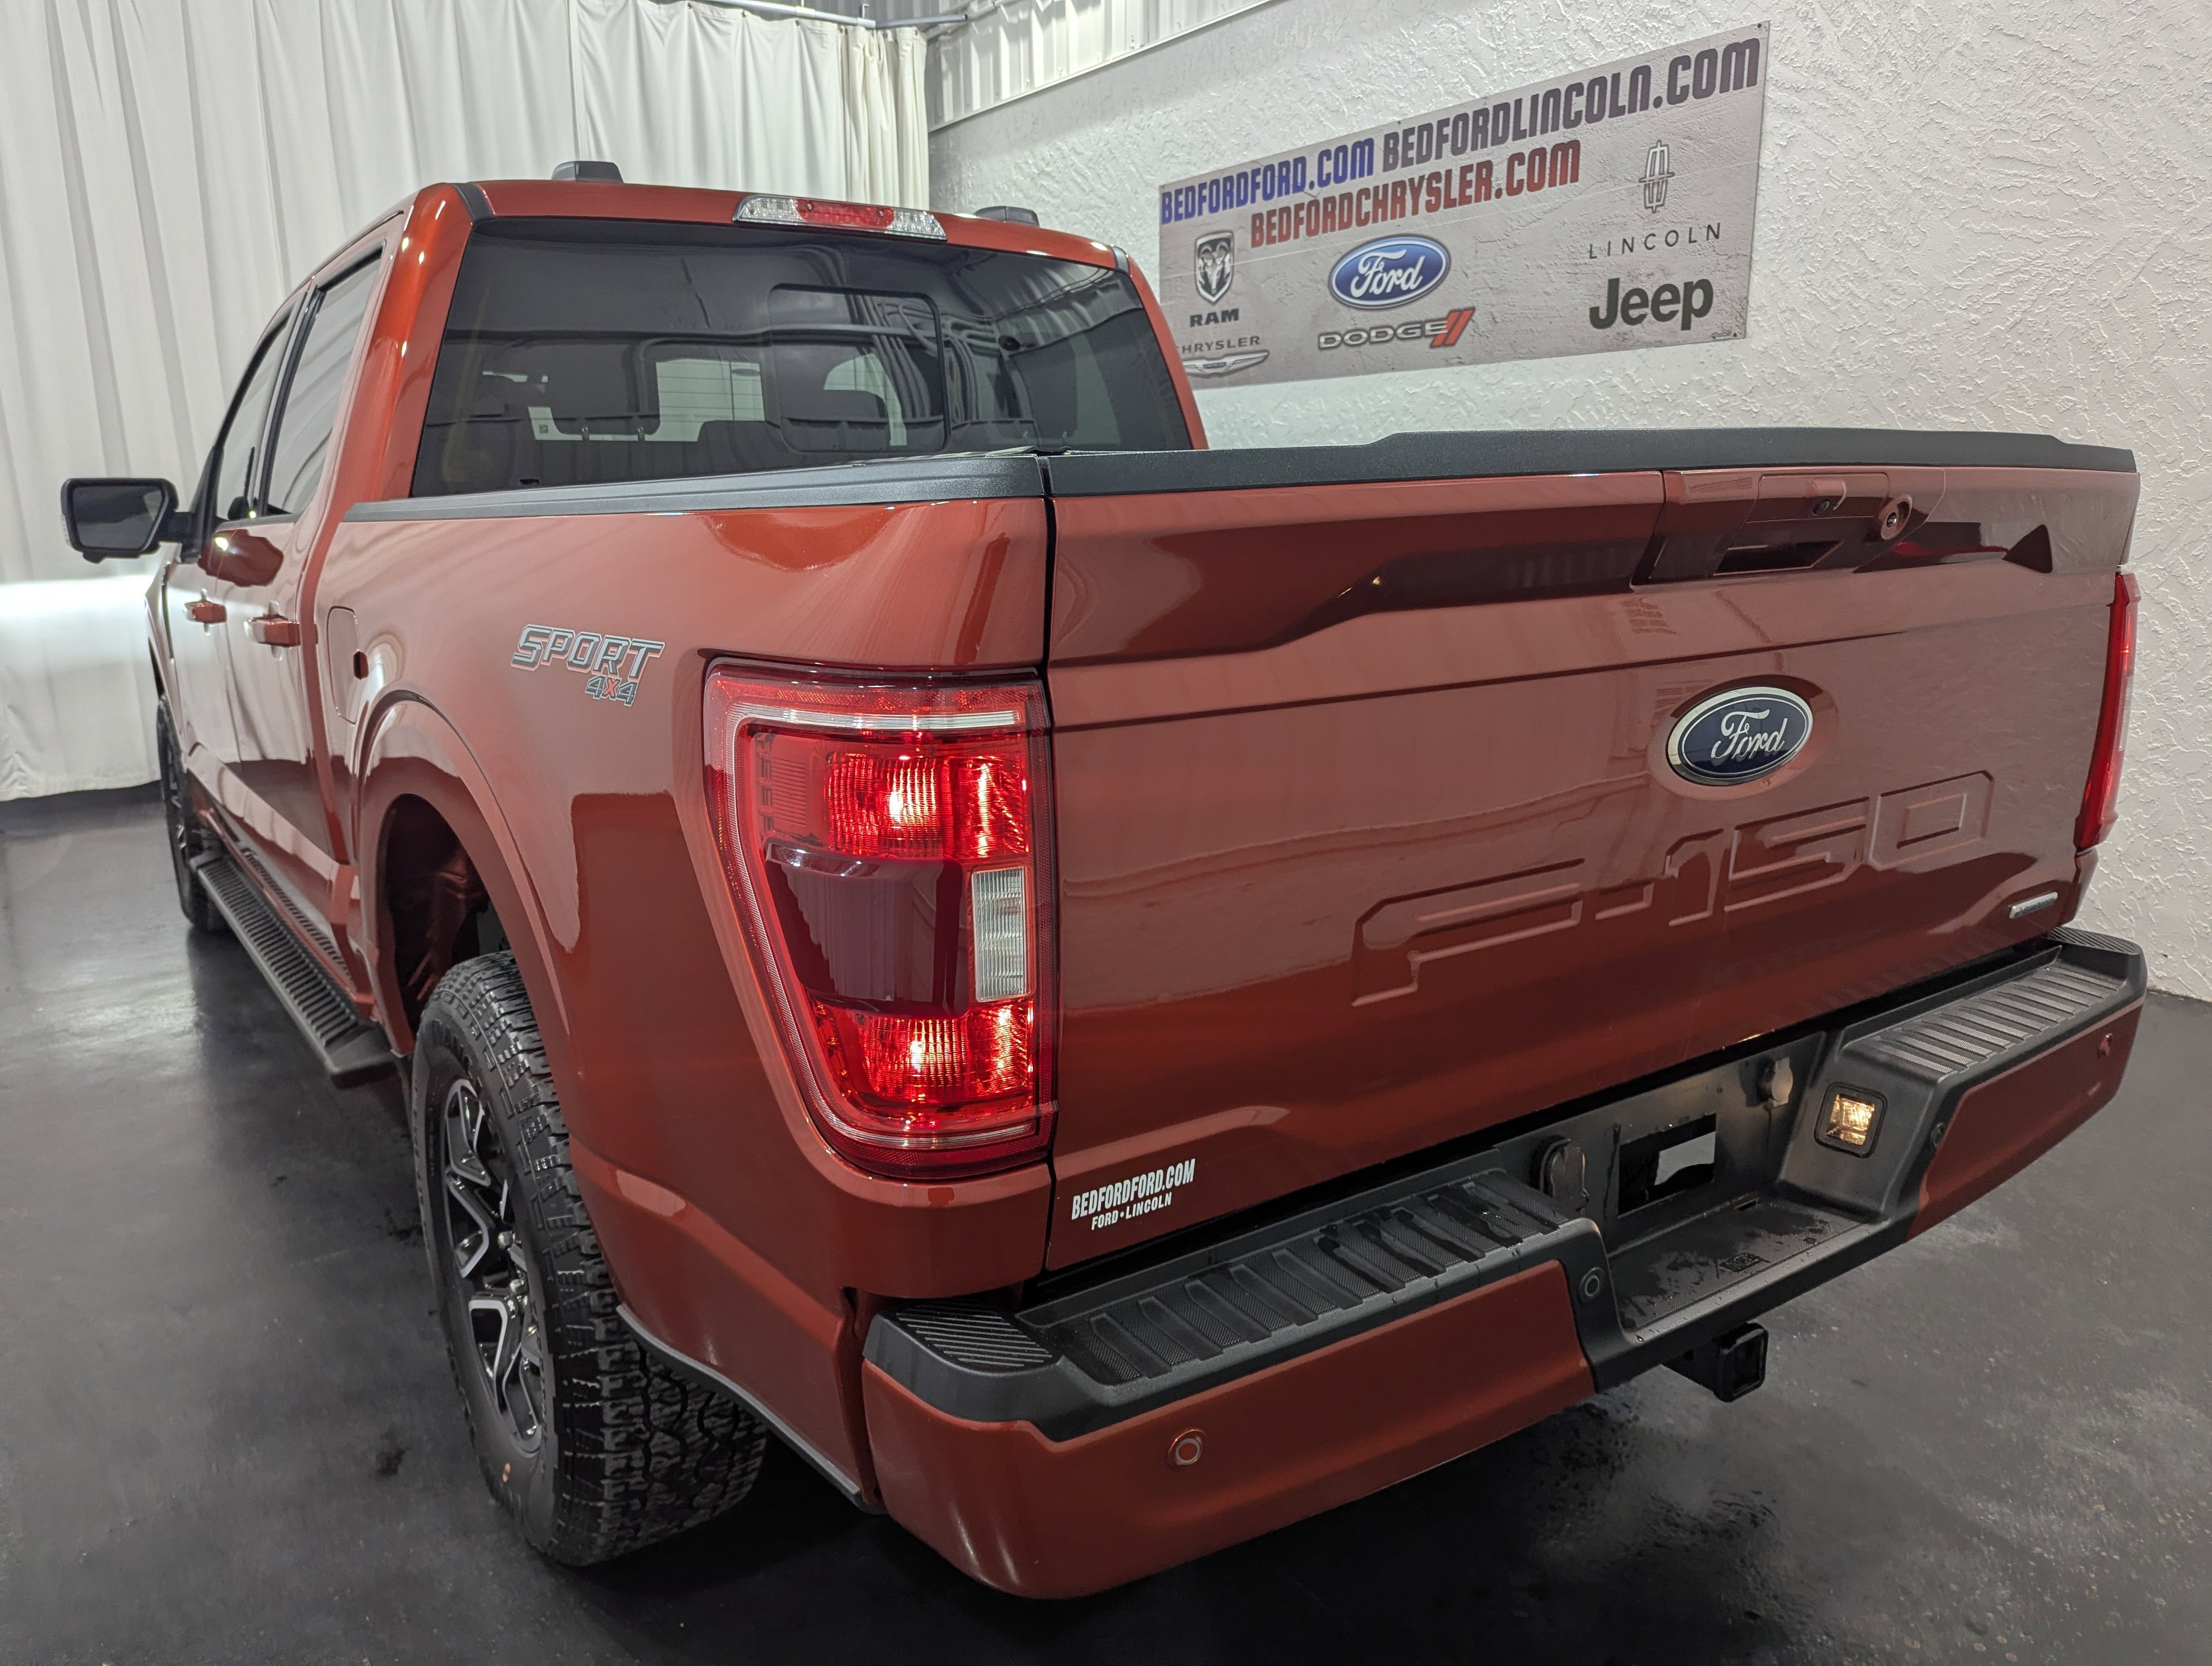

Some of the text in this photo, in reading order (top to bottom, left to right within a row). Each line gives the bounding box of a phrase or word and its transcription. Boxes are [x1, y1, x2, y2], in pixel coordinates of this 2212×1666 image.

[1161, 37, 1760, 225] BEDFORDFORD.COM BEDFORDLINCOLN.COM
[1251, 139, 1581, 248] BEDFORDCHRYSLER.COM
[1589, 222, 1720, 260] LINCOLN
[1350, 249, 1426, 298] Ford
[1189, 308, 1240, 328] RAM
[1589, 277, 1714, 331] Jeep
[1177, 336, 1261, 354] HRYSLER
[1318, 317, 1449, 349] DODGE
[511, 623, 666, 682] SPORT
[1711, 708, 1788, 760] Ford
[1071, 1158, 1195, 1221] BEDFORDFORD.COM
